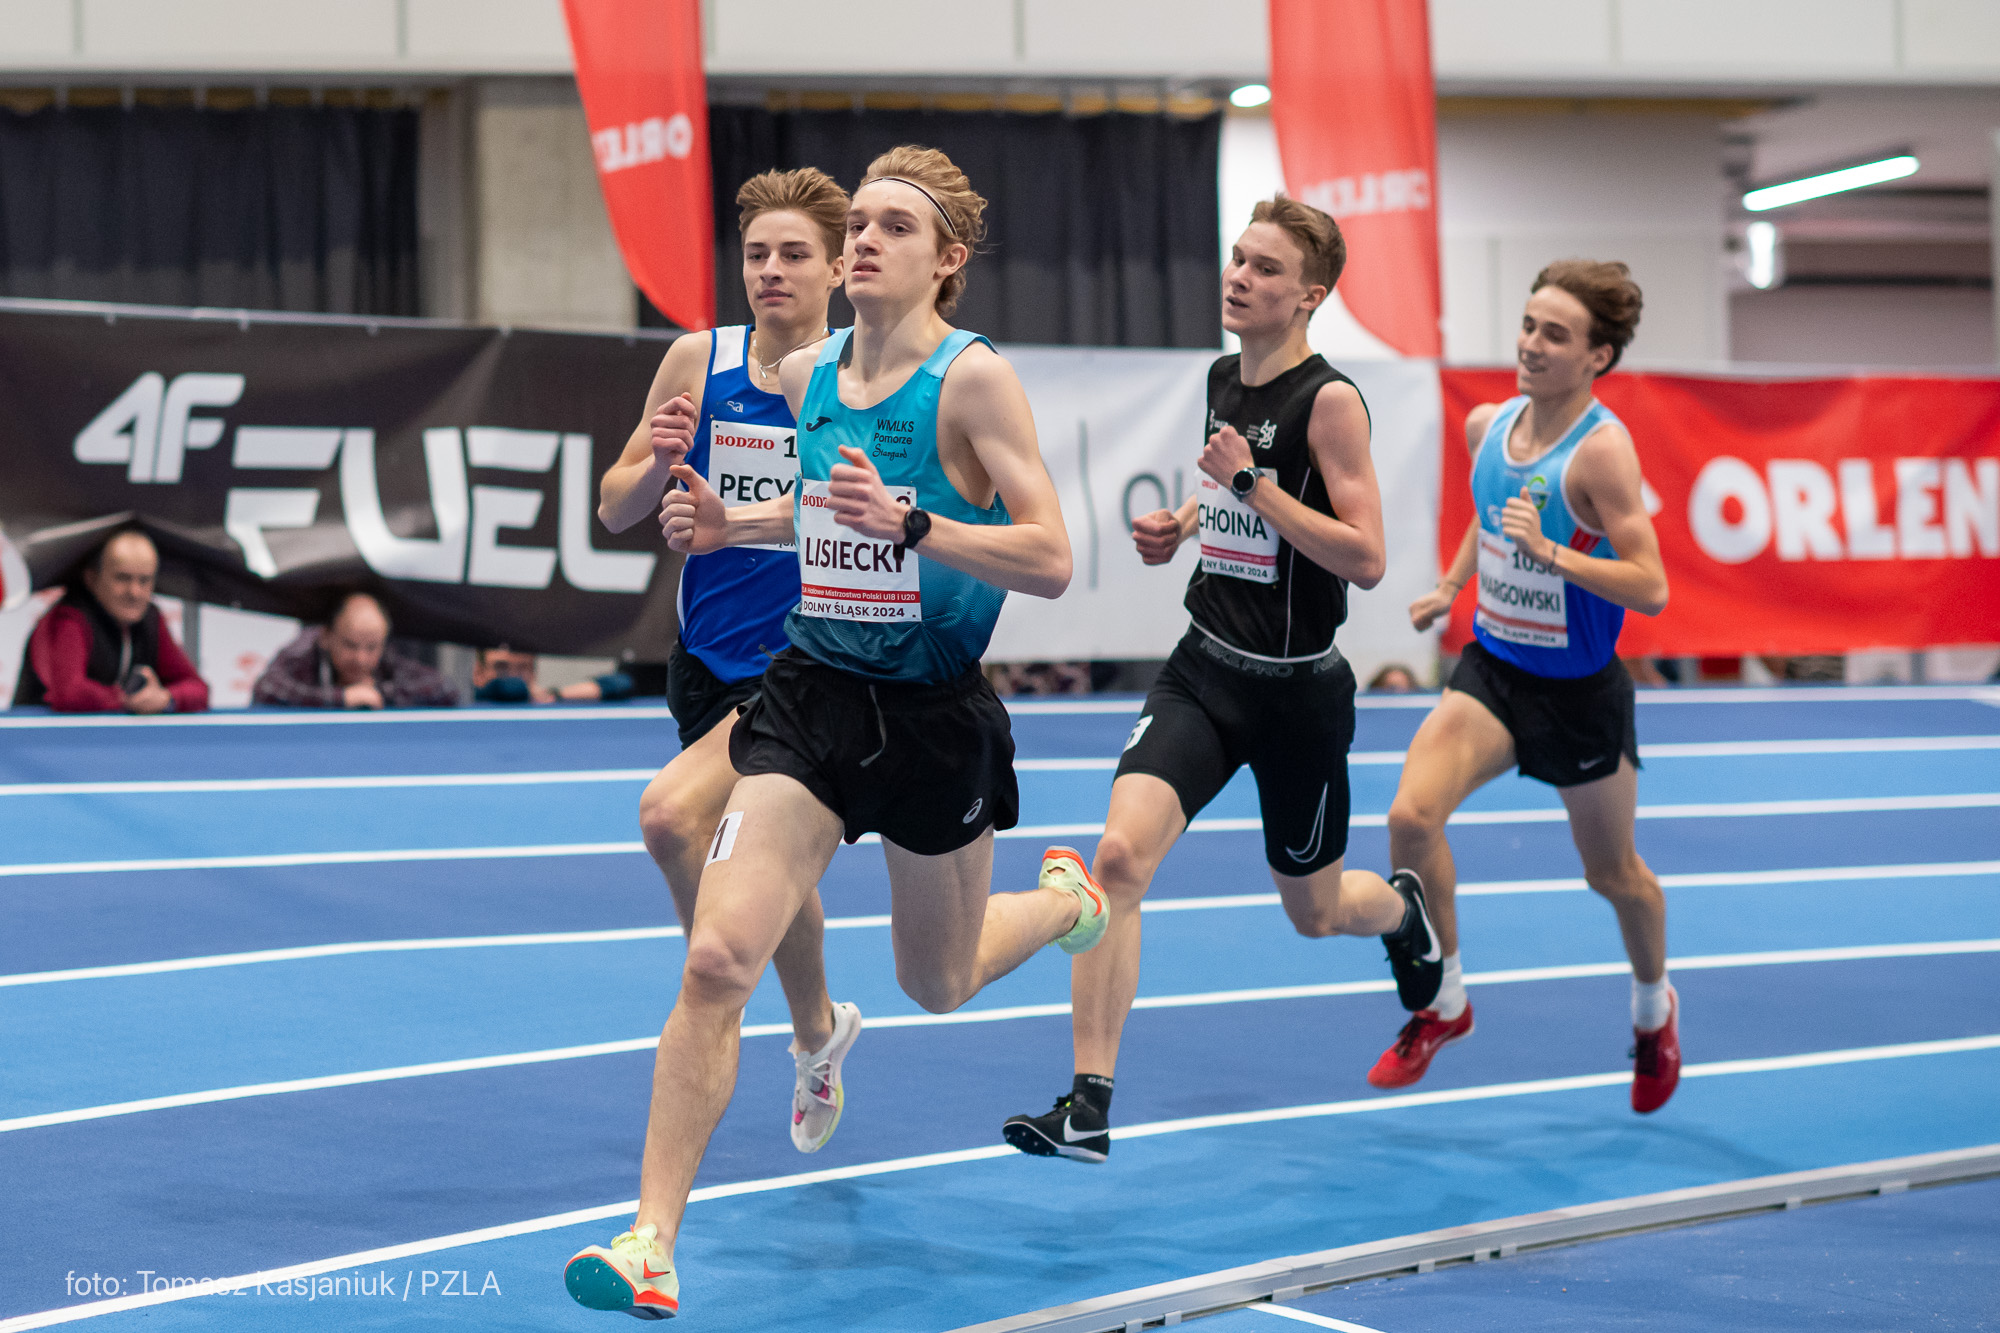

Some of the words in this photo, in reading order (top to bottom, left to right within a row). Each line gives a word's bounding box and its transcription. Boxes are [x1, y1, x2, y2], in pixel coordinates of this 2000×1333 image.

[74, 371, 246, 484] 4F
[873, 432, 913, 445] Pomorze
[877, 418, 915, 432] WMLKS
[715, 434, 775, 451] BODZIO
[783, 435, 798, 459] 1
[872, 443, 908, 461] Stargard
[719, 473, 795, 503] PECY
[225, 426, 656, 594] FUEL
[1198, 504, 1268, 540] CHOINA
[1687, 454, 2000, 565] ORLEN
[1220, 559, 1245, 575] ŚLĄSK
[1247, 566, 1268, 578] 2024
[808, 587, 824, 595] Halowe
[825, 589, 861, 599] Mistrzostwa
[862, 592, 882, 600] Polski
[883, 593, 896, 601] U18
[901, 593, 916, 601] U20
[804, 600, 831, 614] DOLNY
[834, 602, 870, 617] ŚLĄSK
[872, 606, 905, 617] 2024
[1200, 636, 1242, 669] NIKE
[1242, 659, 1294, 678] PRO
[712, 817, 729, 860] 1
